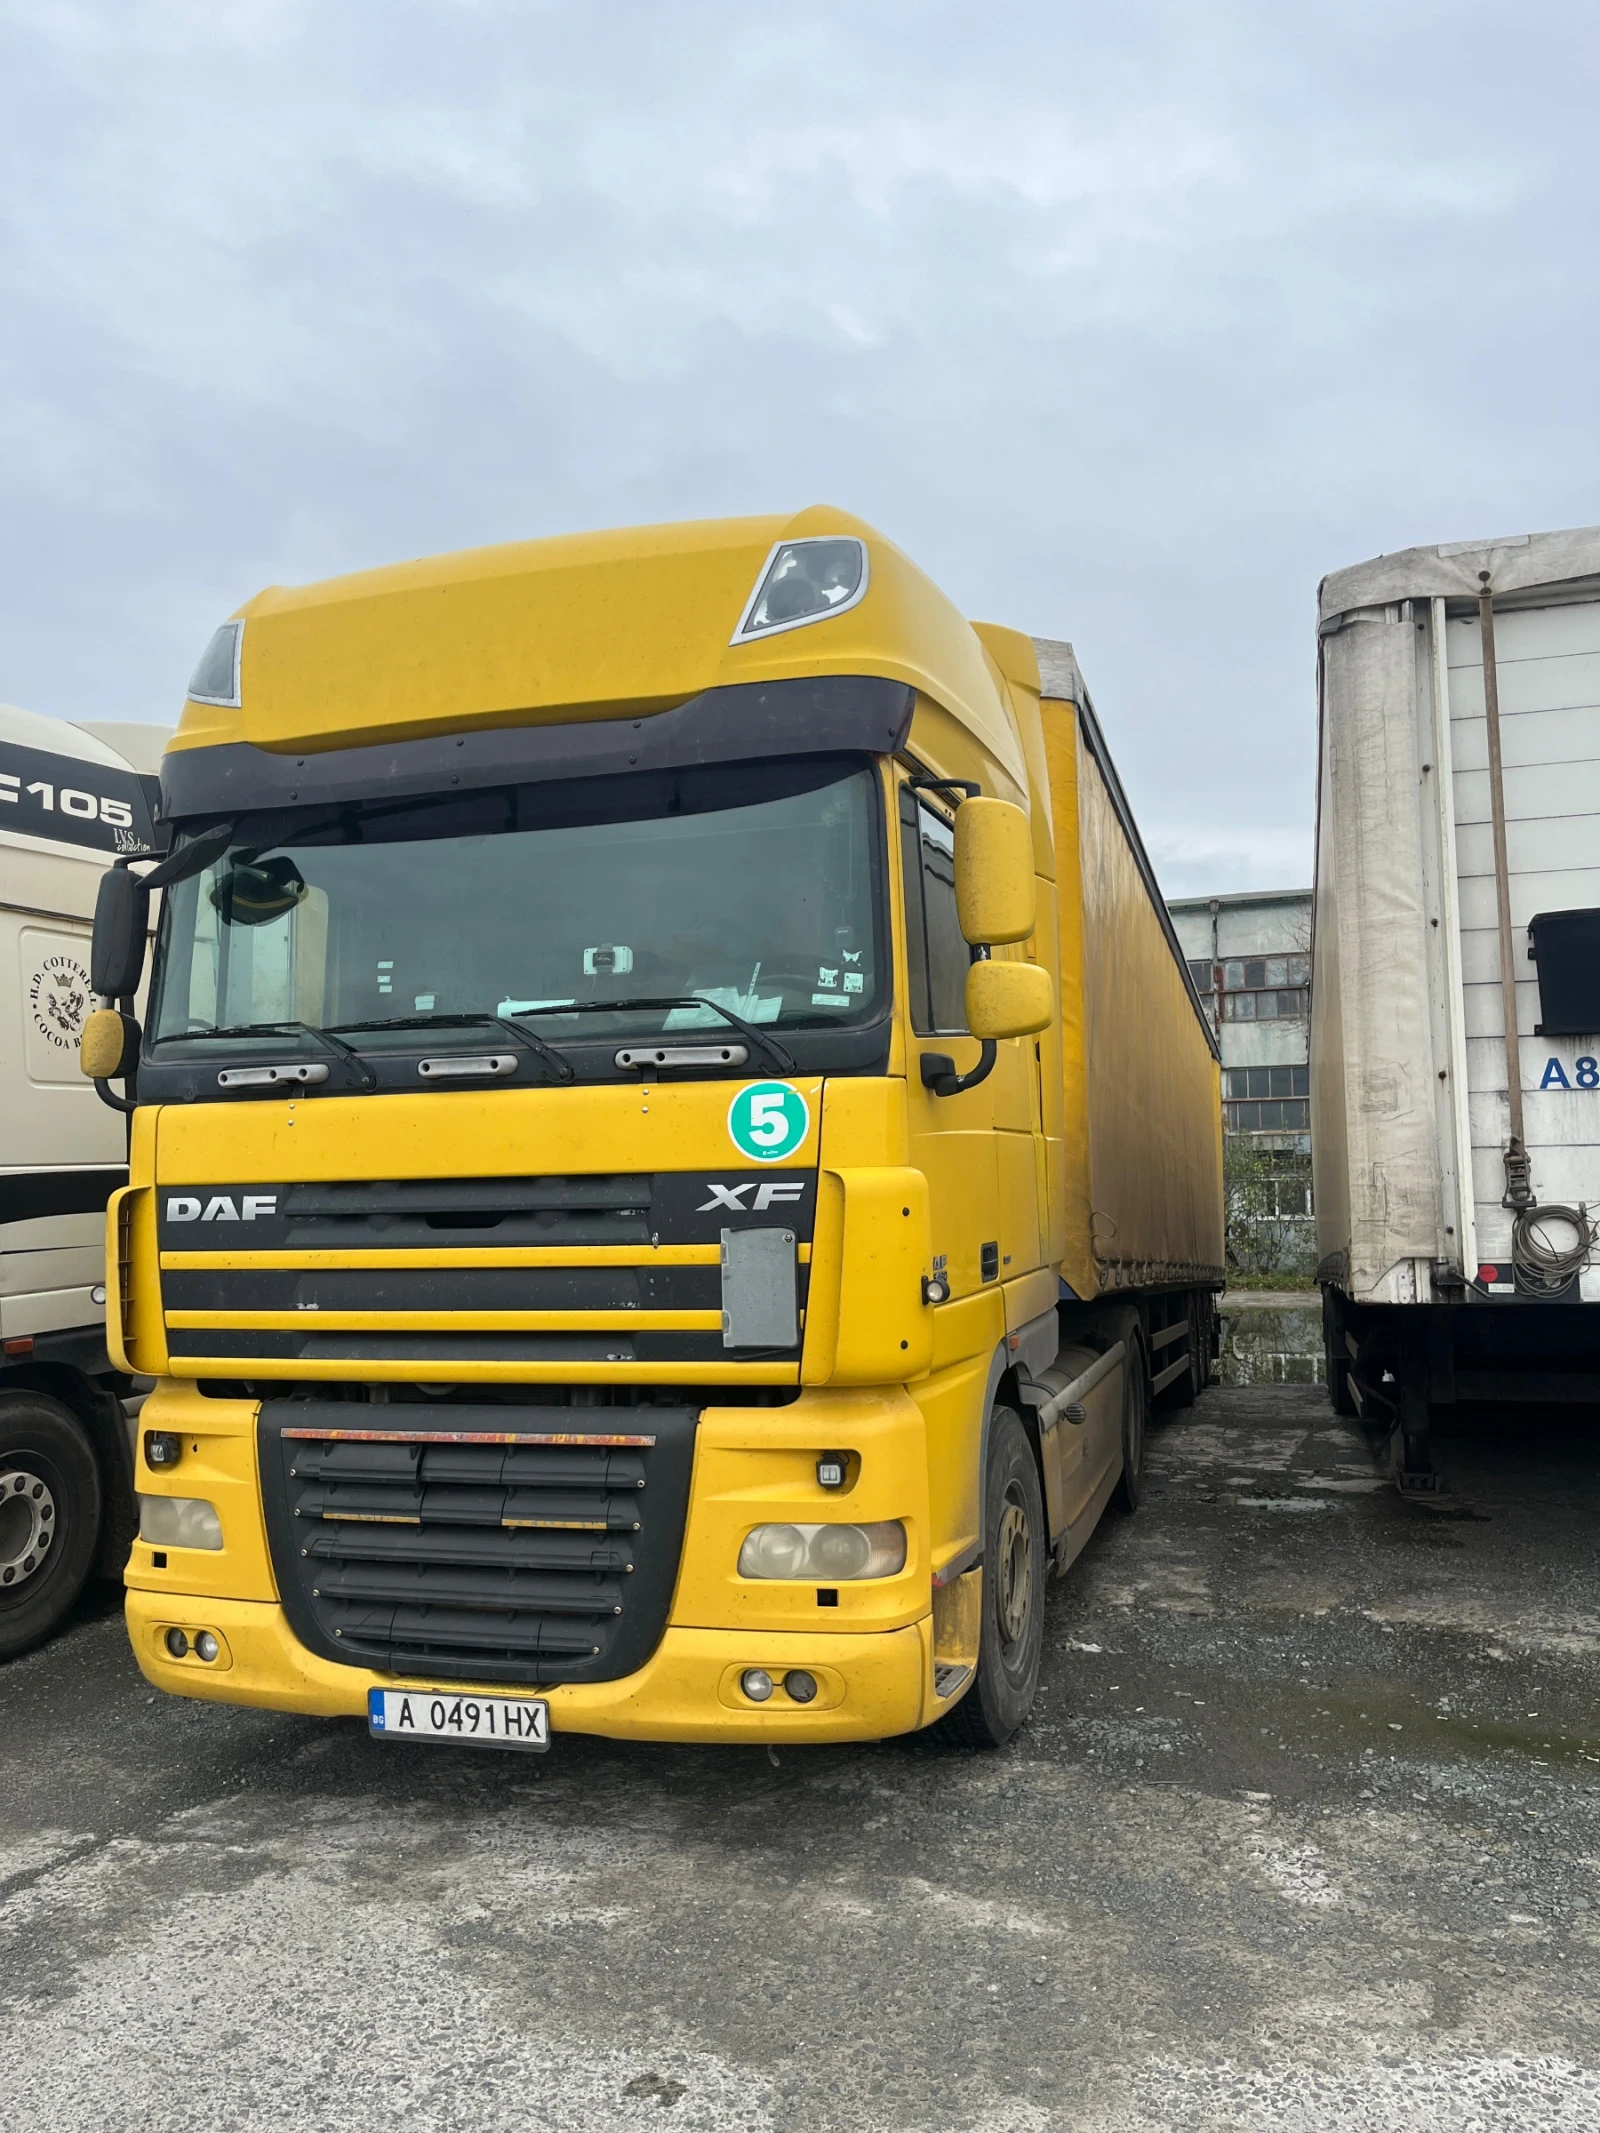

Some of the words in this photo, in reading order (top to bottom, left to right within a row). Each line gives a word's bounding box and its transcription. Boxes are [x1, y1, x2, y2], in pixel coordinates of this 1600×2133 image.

[30, 973, 45, 1000] H.D.
[43, 956, 97, 1006] COTTERELL
[34, 1013, 70, 1049] COCOA
[1539, 1056, 1600, 1089] A8
[749, 1092, 789, 1147] 5
[166, 1195, 277, 1222] DAF
[695, 1182, 805, 1211] XF
[372, 1715, 385, 1725] BG
[399, 1698, 415, 1728] A
